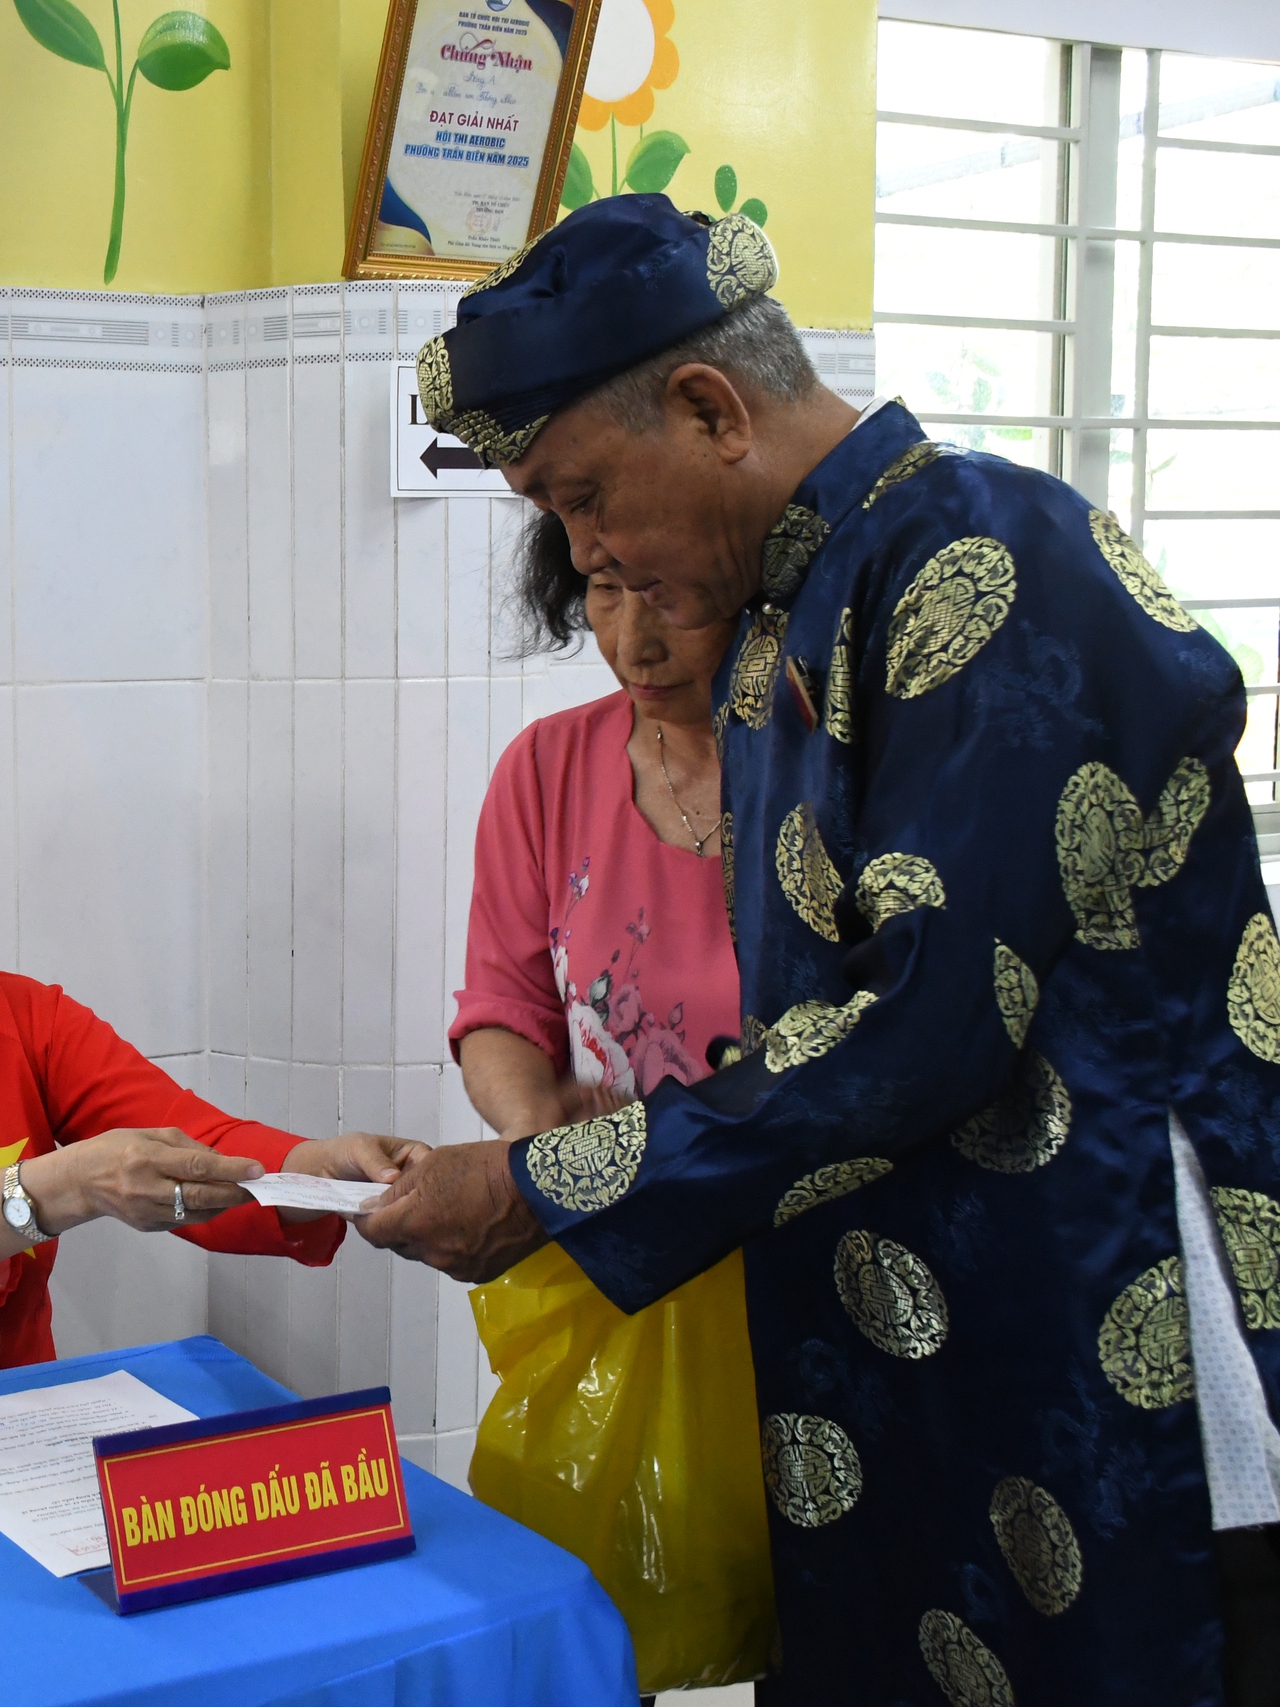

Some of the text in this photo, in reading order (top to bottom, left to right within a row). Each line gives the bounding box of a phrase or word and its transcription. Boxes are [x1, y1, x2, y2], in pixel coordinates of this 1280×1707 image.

[510, 18, 530, 27] AEROBIC
[490, 51, 532, 73] Nhận
[430, 110, 519, 131] ĐẠT GIẢI NHẤT
[436, 130, 506, 148] HỘI THI AEROBIC
[404, 144, 440, 158] PHƯỜNG
[465, 149, 486, 163] BIÊN
[486, 151, 505, 166] NĂM
[507, 155, 529, 168] 2025
[122, 1495, 176, 1548] BÀN
[180, 1484, 249, 1536] ĐÓNG
[251, 1463, 300, 1521] DẤU
[305, 1460, 339, 1511] ĐÃ
[340, 1447, 390, 1504] BẦU
